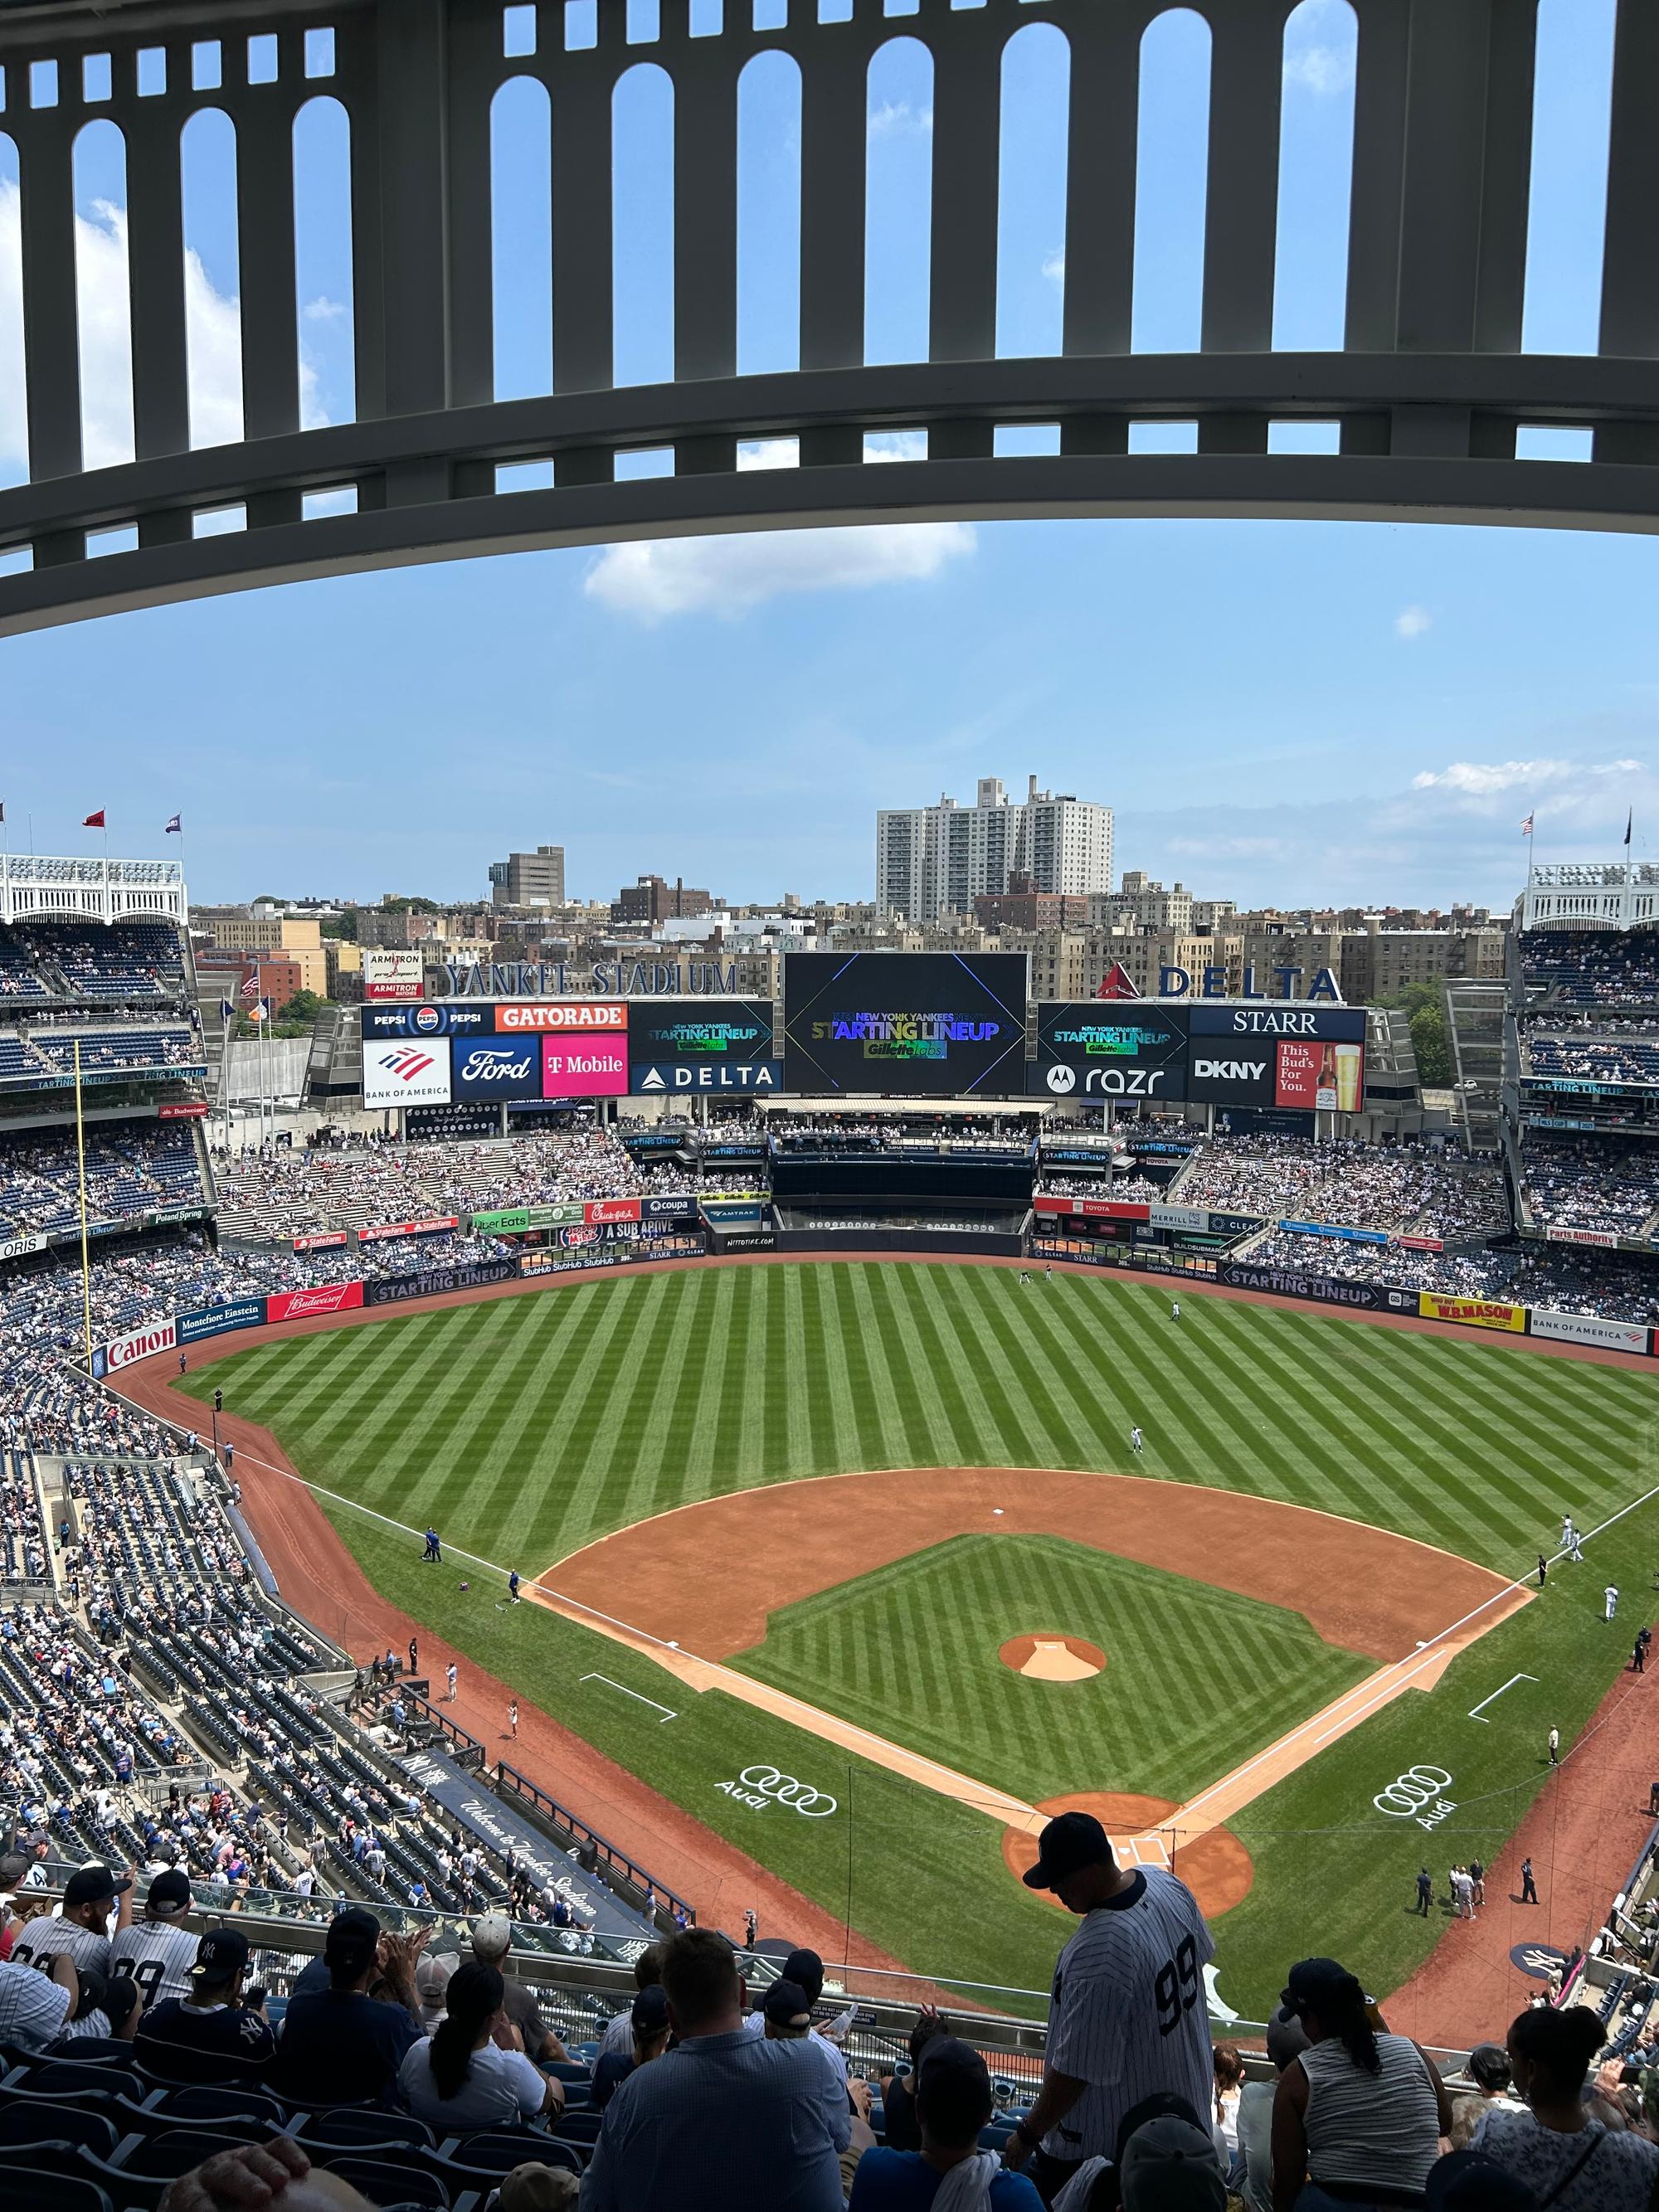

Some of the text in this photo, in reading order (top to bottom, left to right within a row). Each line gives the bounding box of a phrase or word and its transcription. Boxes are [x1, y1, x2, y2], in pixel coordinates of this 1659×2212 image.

[444, 963, 737, 996] YANKEE STADIUM
[1161, 966, 1342, 1001] DELTA
[374, 984, 418, 993] ARMITRON
[374, 1015, 406, 1025] PEPSI
[450, 1014, 481, 1023] PEPSI
[503, 1007, 621, 1027] GATORADE
[856, 1013, 878, 1021] NEW
[880, 1013, 909, 1022] YORK
[911, 1014, 954, 1022] YANKEES
[1233, 1010, 1318, 1034] STARR
[711, 1028, 758, 1039] LINEUP
[811, 1022, 1000, 1041] STARTING LINEUP
[1054, 1031, 1171, 1044] STARTING LINEUP
[1281, 1044, 1309, 1056] This
[462, 1050, 532, 1081] Ford
[567, 1054, 623, 1073] Mobile
[1194, 1059, 1267, 1080] DKNY
[1281, 1057, 1314, 1068] Bud's
[675, 1067, 773, 1087] DELTA
[1281, 1068, 1301, 1079] For
[1086, 1068, 1164, 1094] razr
[1280, 1080, 1306, 1091] You.
[366, 1091, 391, 1099] BANK
[406, 1087, 448, 1096] AMERICA
[1583, 1086, 1624, 1095] LINEUP
[173, 1106, 207, 1115] Budweiser
[1131, 1144, 1167, 1154] STARTING
[1044, 1153, 1079, 1161] STARTING
[662, 1201, 688, 1210] coupa
[155, 1209, 202, 1223] Poland Spring
[502, 1216, 526, 1228] Eats
[1151, 1214, 1186, 1223] MERRILL
[93, 1225, 116, 1236] LINEUP
[606, 1226, 614, 1238] A
[616, 1224, 639, 1237] SUB
[1230, 1222, 1259, 1231] CLEAR
[727, 1237, 774, 1247] NITTOTIRE.COM
[1550, 1229, 1572, 1239] Parts
[1574, 1232, 1613, 1244] Authority
[4, 1238, 36, 1257] ORIS
[1073, 1254, 1098, 1264] STARR
[523, 1257, 614, 1276] StubHub StubHub StubHub
[1146, 1264, 1217, 1281] StubHub StubHub StubHub
[417, 1273, 431, 1281] NEW
[432, 1270, 450, 1278] YORK
[1270, 1271, 1286, 1280] NEW
[1286, 1273, 1303, 1281] YORK
[378, 1266, 508, 1300] STARTING LINEUP
[1231, 1270, 1372, 1303] STARTING LINEUP
[291, 1293, 342, 1310] Budweiser
[182, 1305, 259, 1330] Montefiore Einstein
[1533, 1320, 1559, 1329] BANK
[1576, 1326, 1621, 1339] AMERICA
[109, 1325, 174, 1367] Canon
[713, 1781, 771, 1809] Audi
[1415, 1798, 1457, 1830] Audi
[460, 1799, 597, 1917] Welcome to Yankee Stadium
[1154, 1934, 1198, 2037] 99
